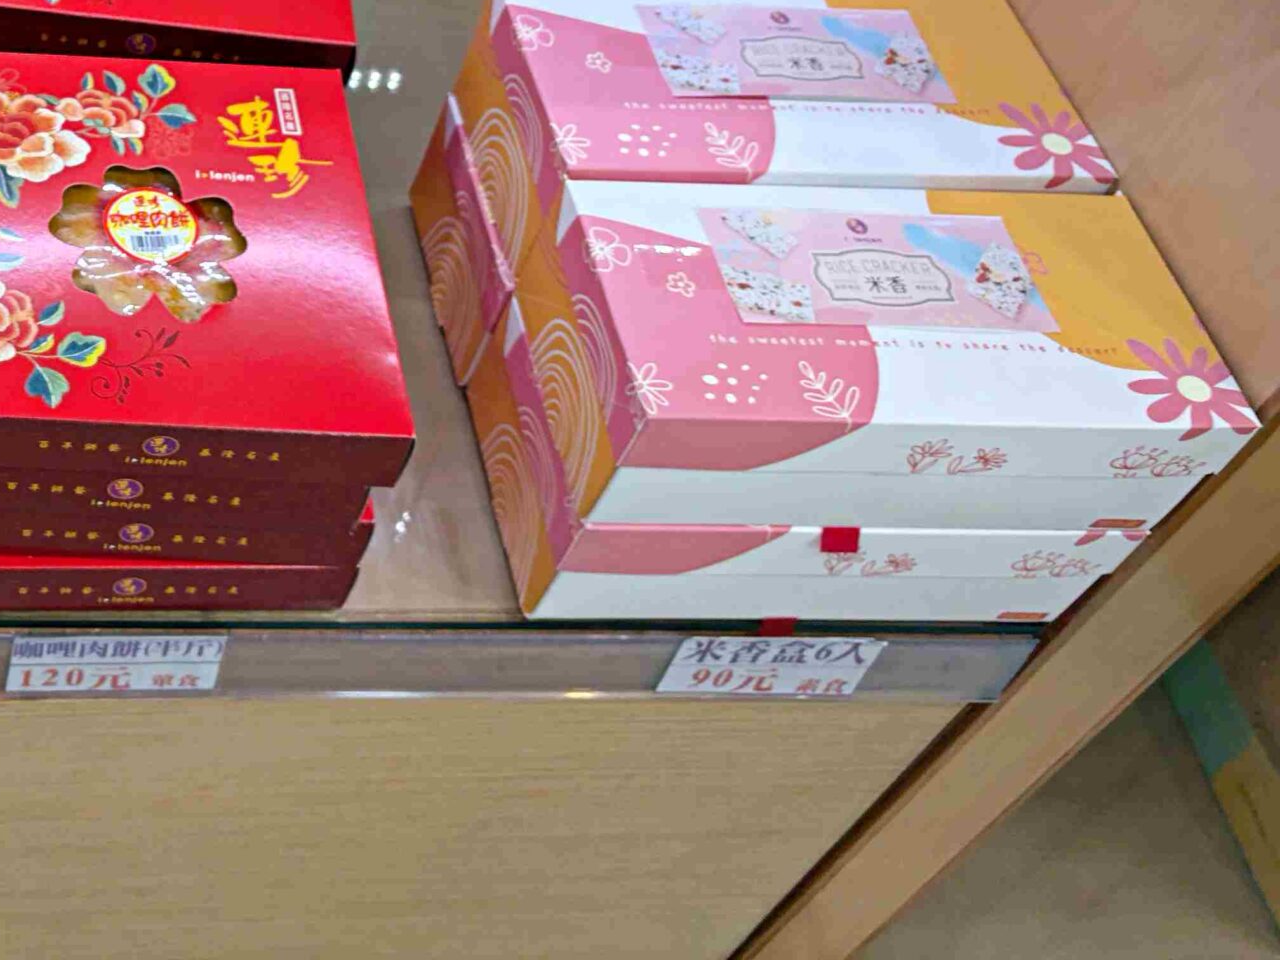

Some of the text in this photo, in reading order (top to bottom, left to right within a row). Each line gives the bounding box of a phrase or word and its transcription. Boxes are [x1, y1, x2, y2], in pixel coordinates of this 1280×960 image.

[865, 276, 908, 294] 米香
[709, 334, 738, 344] the
[21, 666, 132, 691] 120元
[687, 667, 780, 692] 90元
